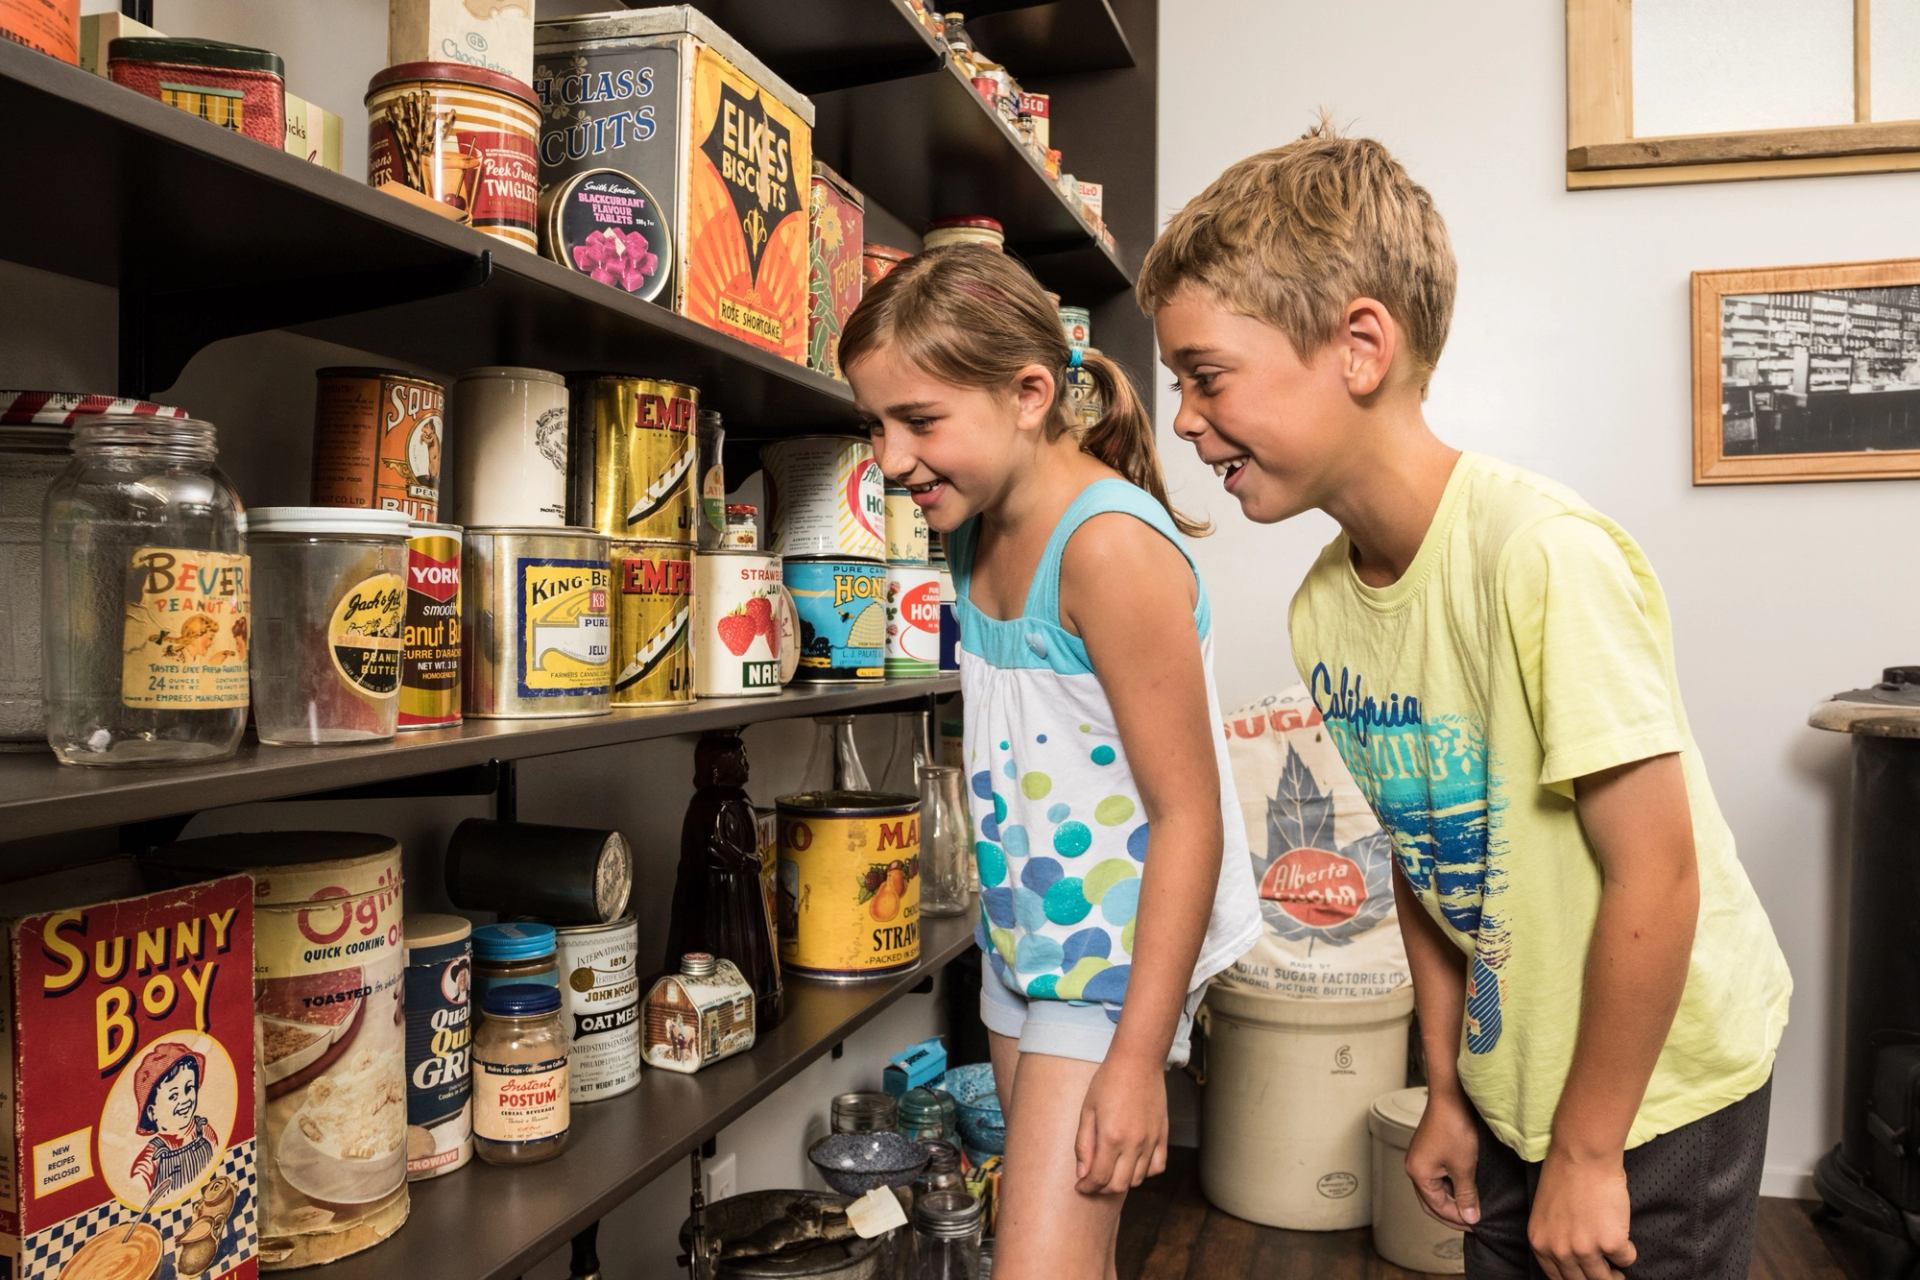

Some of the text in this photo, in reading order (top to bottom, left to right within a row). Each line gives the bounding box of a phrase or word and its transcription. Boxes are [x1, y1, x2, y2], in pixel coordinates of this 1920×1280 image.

[561, 67, 655, 104] CLASS
[578, 192, 645, 208] BLACKCURRANT
[592, 203, 632, 216] FLAVOUR
[594, 212, 633, 225] TABLETS
[721, 302, 780, 340] ROSE SHORTCAKE
[411, 566, 459, 584] YORK
[833, 565, 862, 574] PURE
[155, 597, 223, 614] PEANUT
[418, 662, 432, 671] NET
[148, 675, 166, 691] 24
[156, 694, 192, 702] EMPRESS
[1273, 862, 1349, 892] Alberta
[43, 908, 236, 993] SUNNY
[304, 935, 385, 962] QUICK COOKING
[610, 955, 626, 967] 1876
[869, 953, 902, 964] PACKED
[1274, 968, 1316, 983] SUGAR
[1322, 971, 1385, 985] FACTORIES
[585, 989, 613, 1003] JOHN
[1276, 982, 1318, 994] PICTURE
[302, 985, 372, 1009] TOASTED
[96, 962, 215, 1071] BOY
[581, 1014, 614, 1032] OAT
[1335, 1044, 1352, 1069] 6
[501, 1076, 554, 1092] Instant
[499, 1089, 556, 1107] POSTUM
[526, 1106, 555, 1115] BEVERAGE
[53, 1144, 70, 1158] NEW
[48, 1155, 76, 1172] RECIPES
[43, 1165, 81, 1186] ENCLOSED
